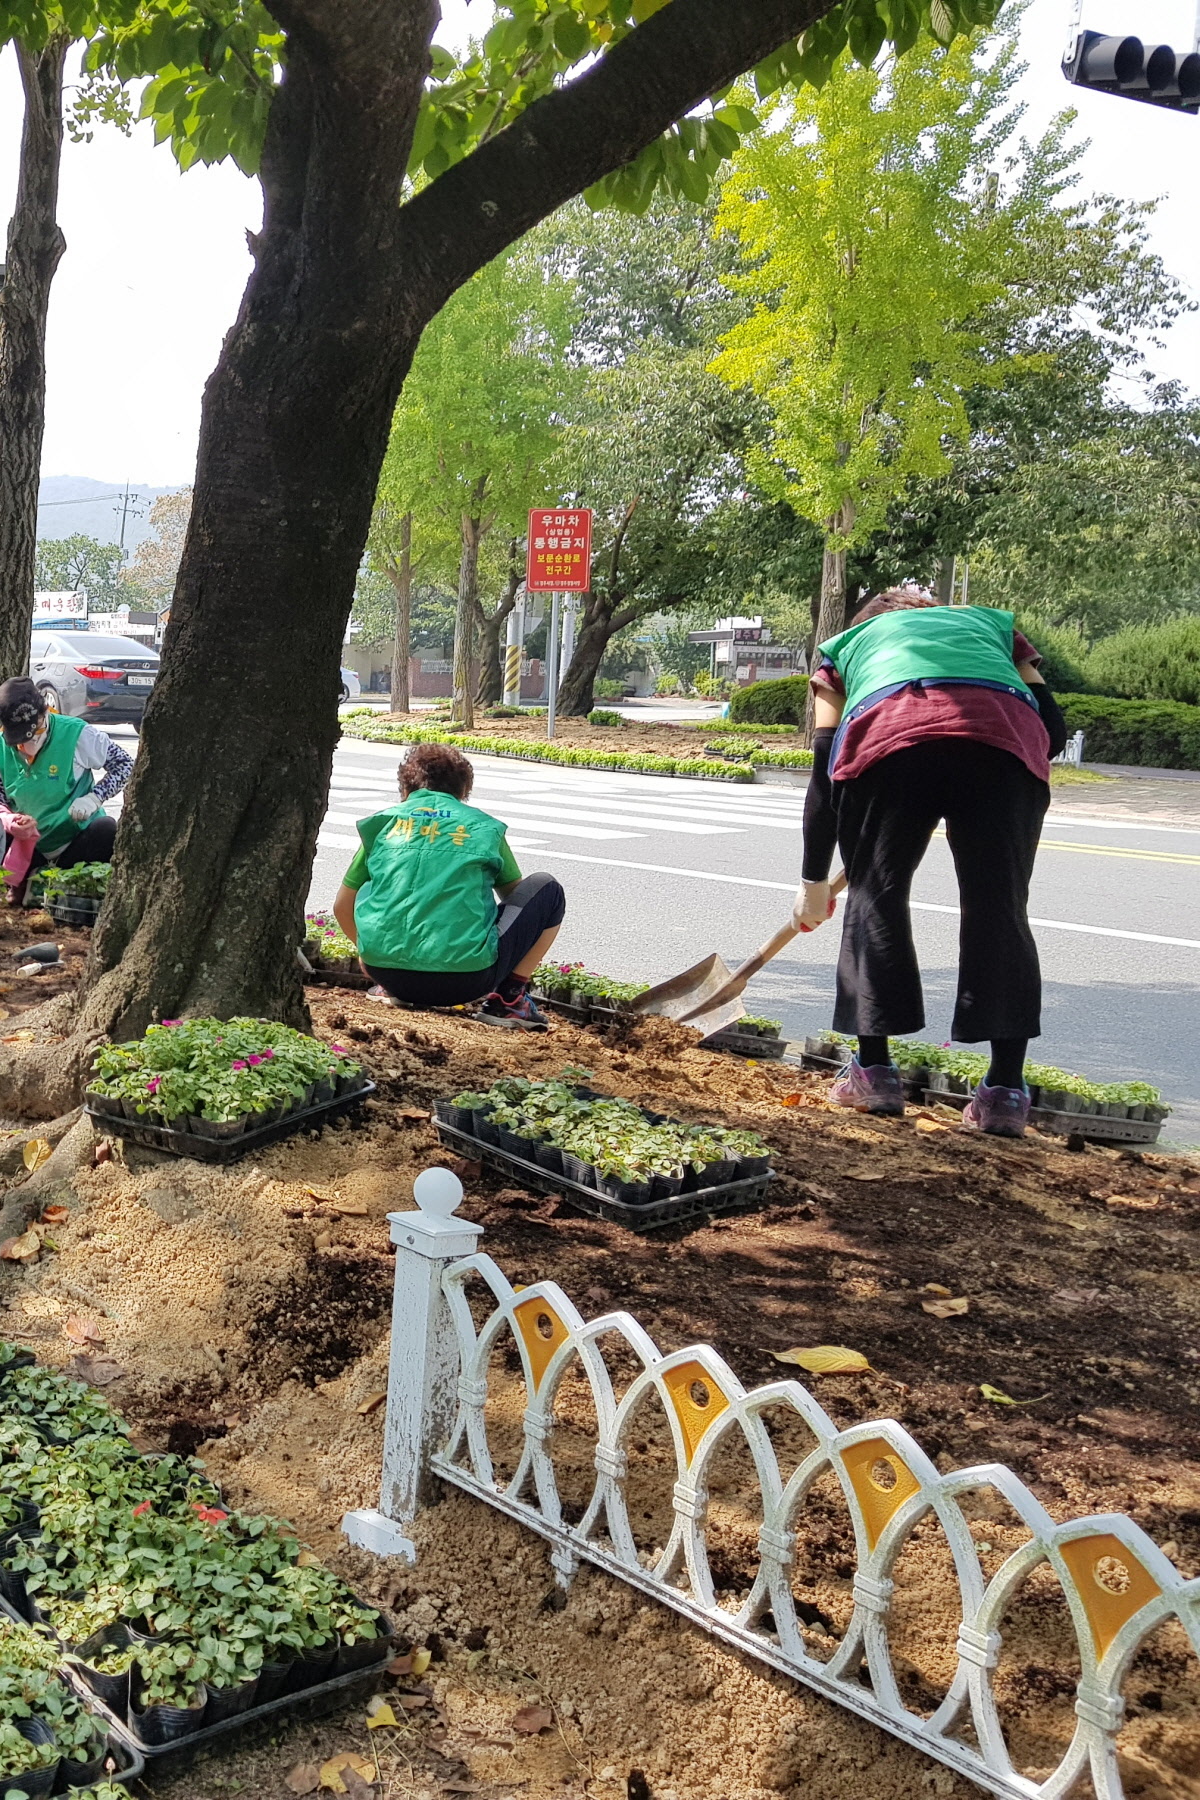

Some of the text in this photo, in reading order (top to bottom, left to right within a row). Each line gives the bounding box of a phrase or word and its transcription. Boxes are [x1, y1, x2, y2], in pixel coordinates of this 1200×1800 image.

[541, 515, 579, 527] 우마차
[534, 537, 585, 549] 통행금지
[536, 553, 581, 563] 보문순환로
[545, 565, 571, 575] 전구간
[386, 817, 472, 846] 새마을
